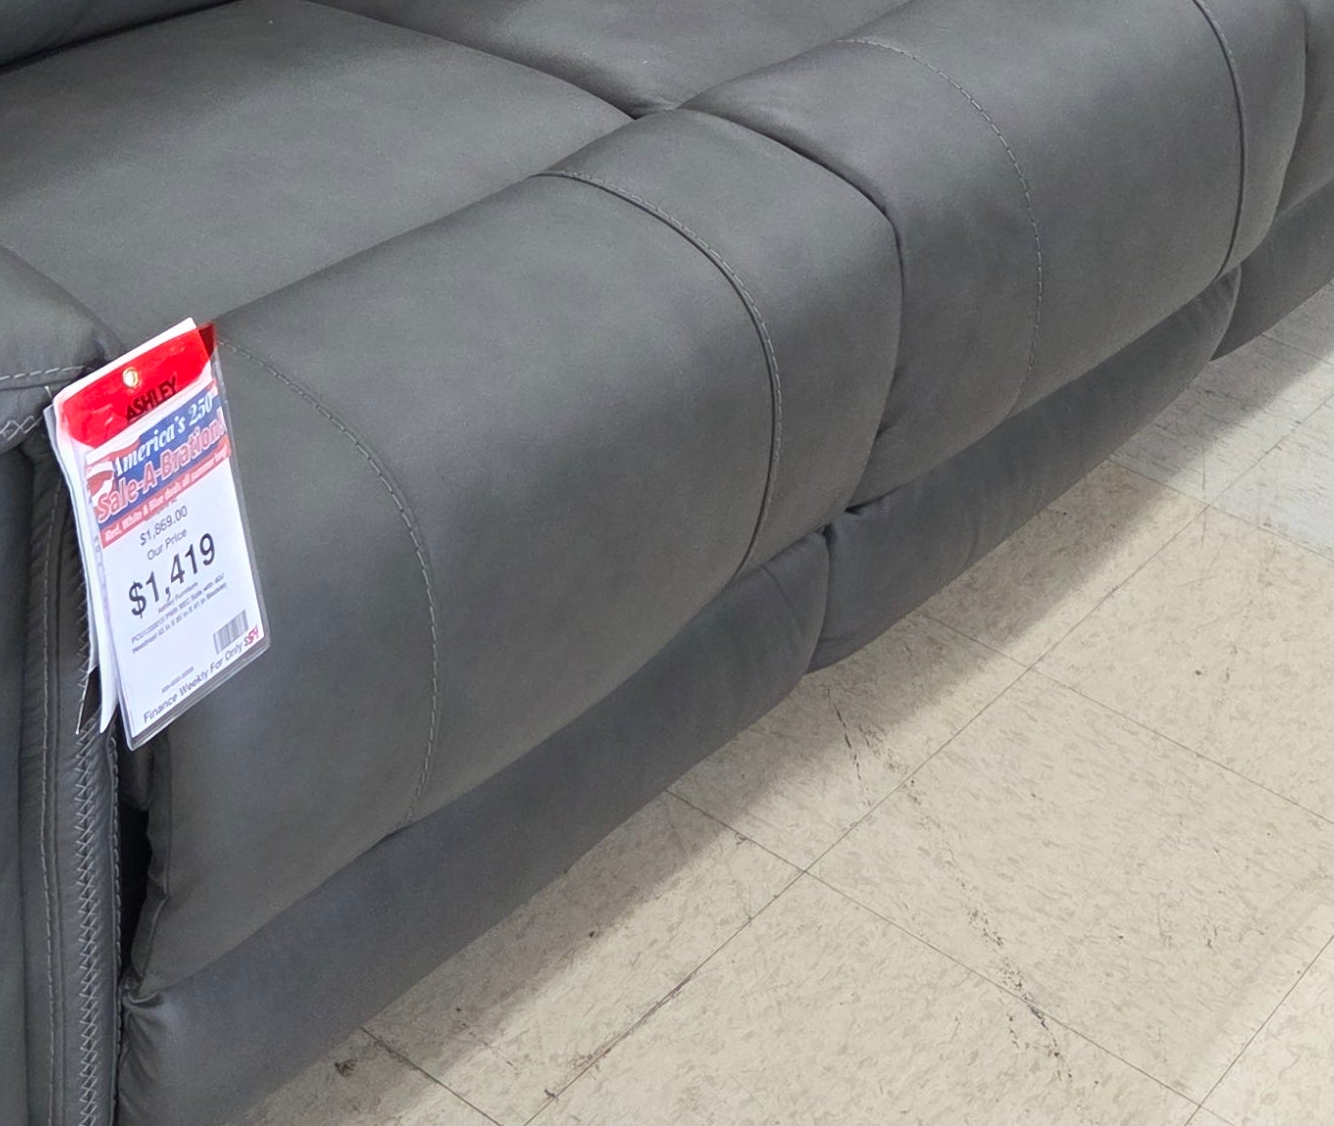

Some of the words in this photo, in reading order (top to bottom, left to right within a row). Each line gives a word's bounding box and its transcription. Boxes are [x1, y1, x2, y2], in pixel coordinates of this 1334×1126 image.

[126, 373, 177, 420] ASHLEY
[97, 406, 227, 524] Sale-A-Bration!
[113, 415, 185, 476] America's
[140, 505, 187, 546] $1,869.00
[147, 544, 164, 560] Our
[165, 529, 187, 549] Price
[129, 533, 215, 619] $1,419
[143, 693, 178, 723] Finance
[179, 669, 209, 696] Weekly
[210, 657, 224, 674] For
[225, 641, 243, 662] Only
